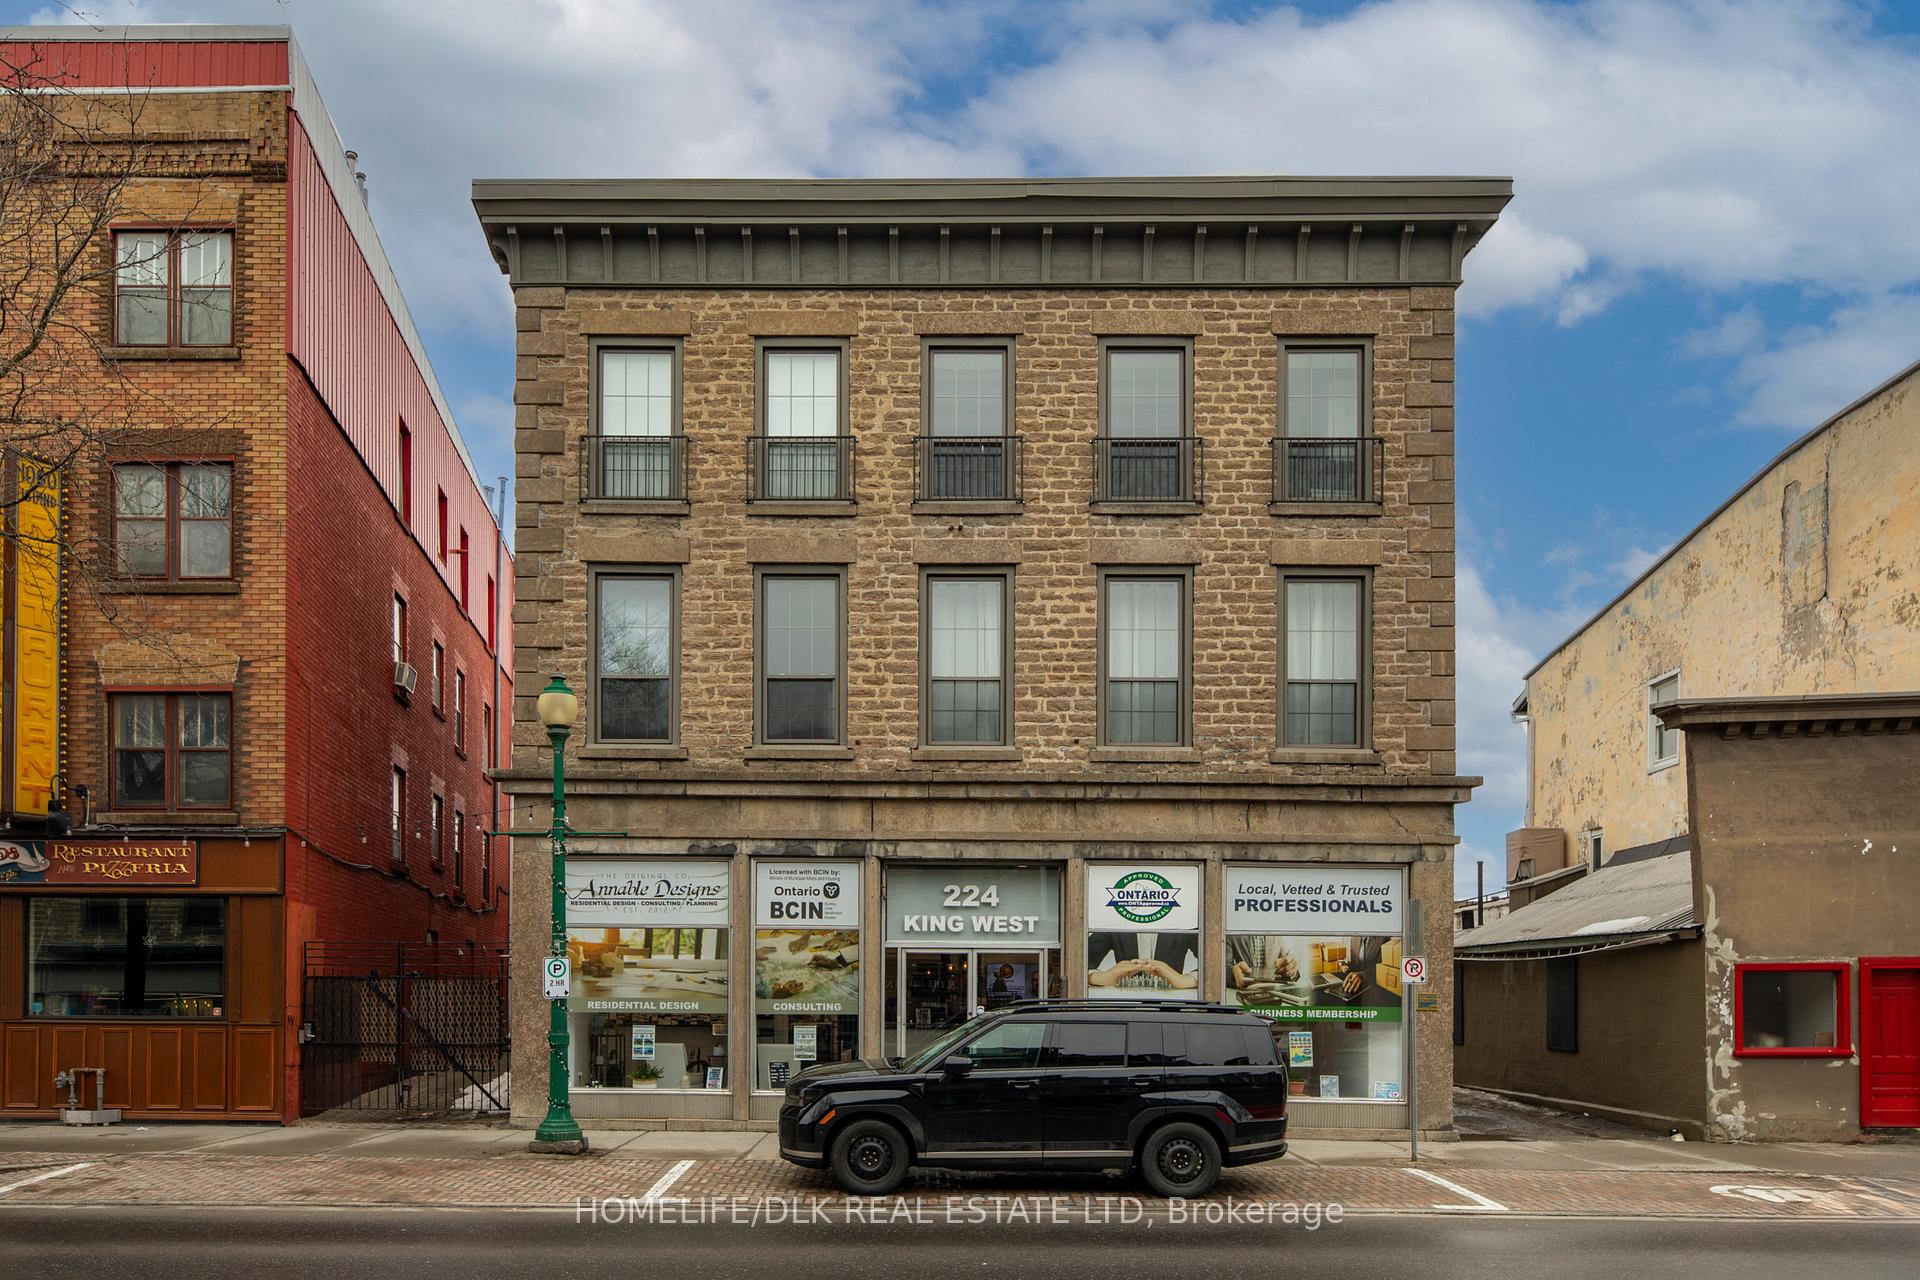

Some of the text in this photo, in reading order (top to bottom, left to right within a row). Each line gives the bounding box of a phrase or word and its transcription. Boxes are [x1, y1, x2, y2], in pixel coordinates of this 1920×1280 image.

[53, 844, 192, 863] RESTAURANT
[831, 868, 841, 877] by:
[1123, 873, 1164, 884] APPROVED
[570, 879, 721, 900] Annable Designs
[774, 886, 821, 896] Ontario
[943, 884, 1000, 907] 224
[1117, 890, 1169, 900] ONTARIO
[1238, 883, 1390, 897] Local, Vetted & Trusted
[770, 901, 823, 919] BCIN
[1234, 898, 1393, 913] PROFESSIONALS
[1119, 907, 1169, 922] PROFESSIONAL
[904, 915, 1040, 933] KING WEST
[553, 963, 562, 974] P
[587, 1001, 699, 1010] RESIDENTIAL DESIGN
[773, 1002, 842, 1011] CONSULTING
[1306, 1009, 1378, 1018] MEMBERSHIP
